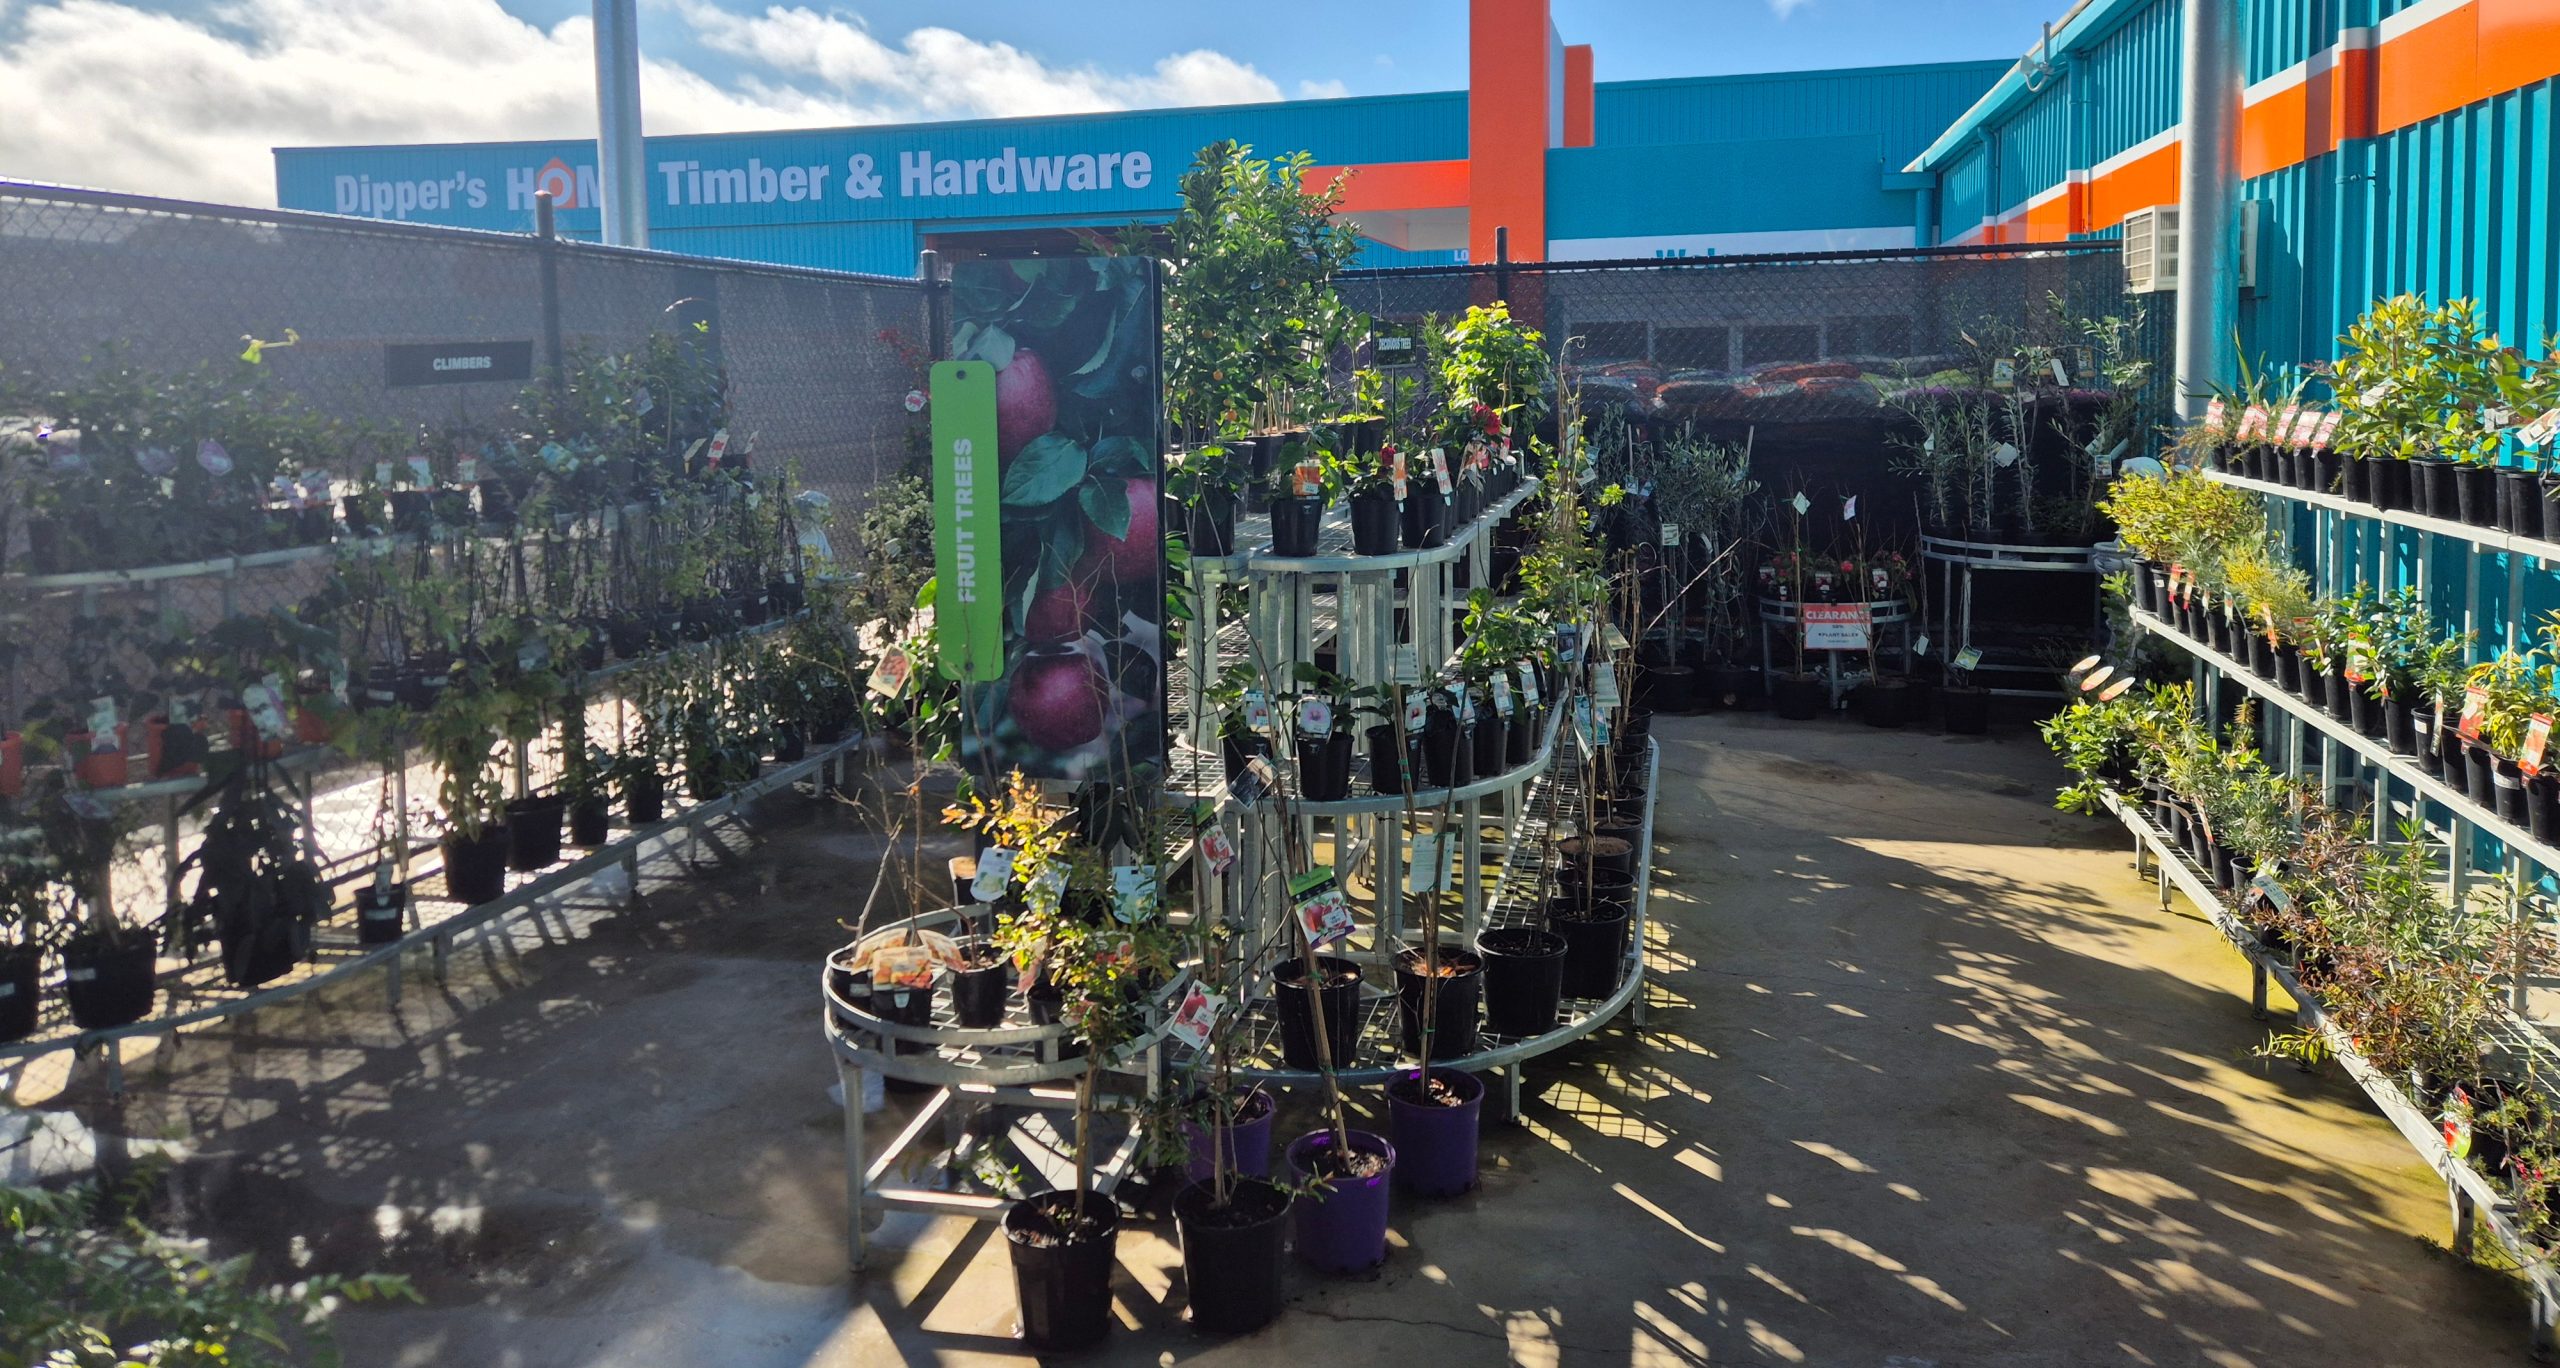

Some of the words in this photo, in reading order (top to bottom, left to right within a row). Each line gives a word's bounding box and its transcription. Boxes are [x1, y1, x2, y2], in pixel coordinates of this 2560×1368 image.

[335, 171, 487, 219] Dipper's
[658, 158, 829, 206] Timber
[844, 153, 883, 199] &
[900, 147, 1152, 198] Hardware
[432, 356, 492, 370] CLIMBERS
[954, 438, 974, 522] TREES
[956, 527, 976, 603] FRUIT
